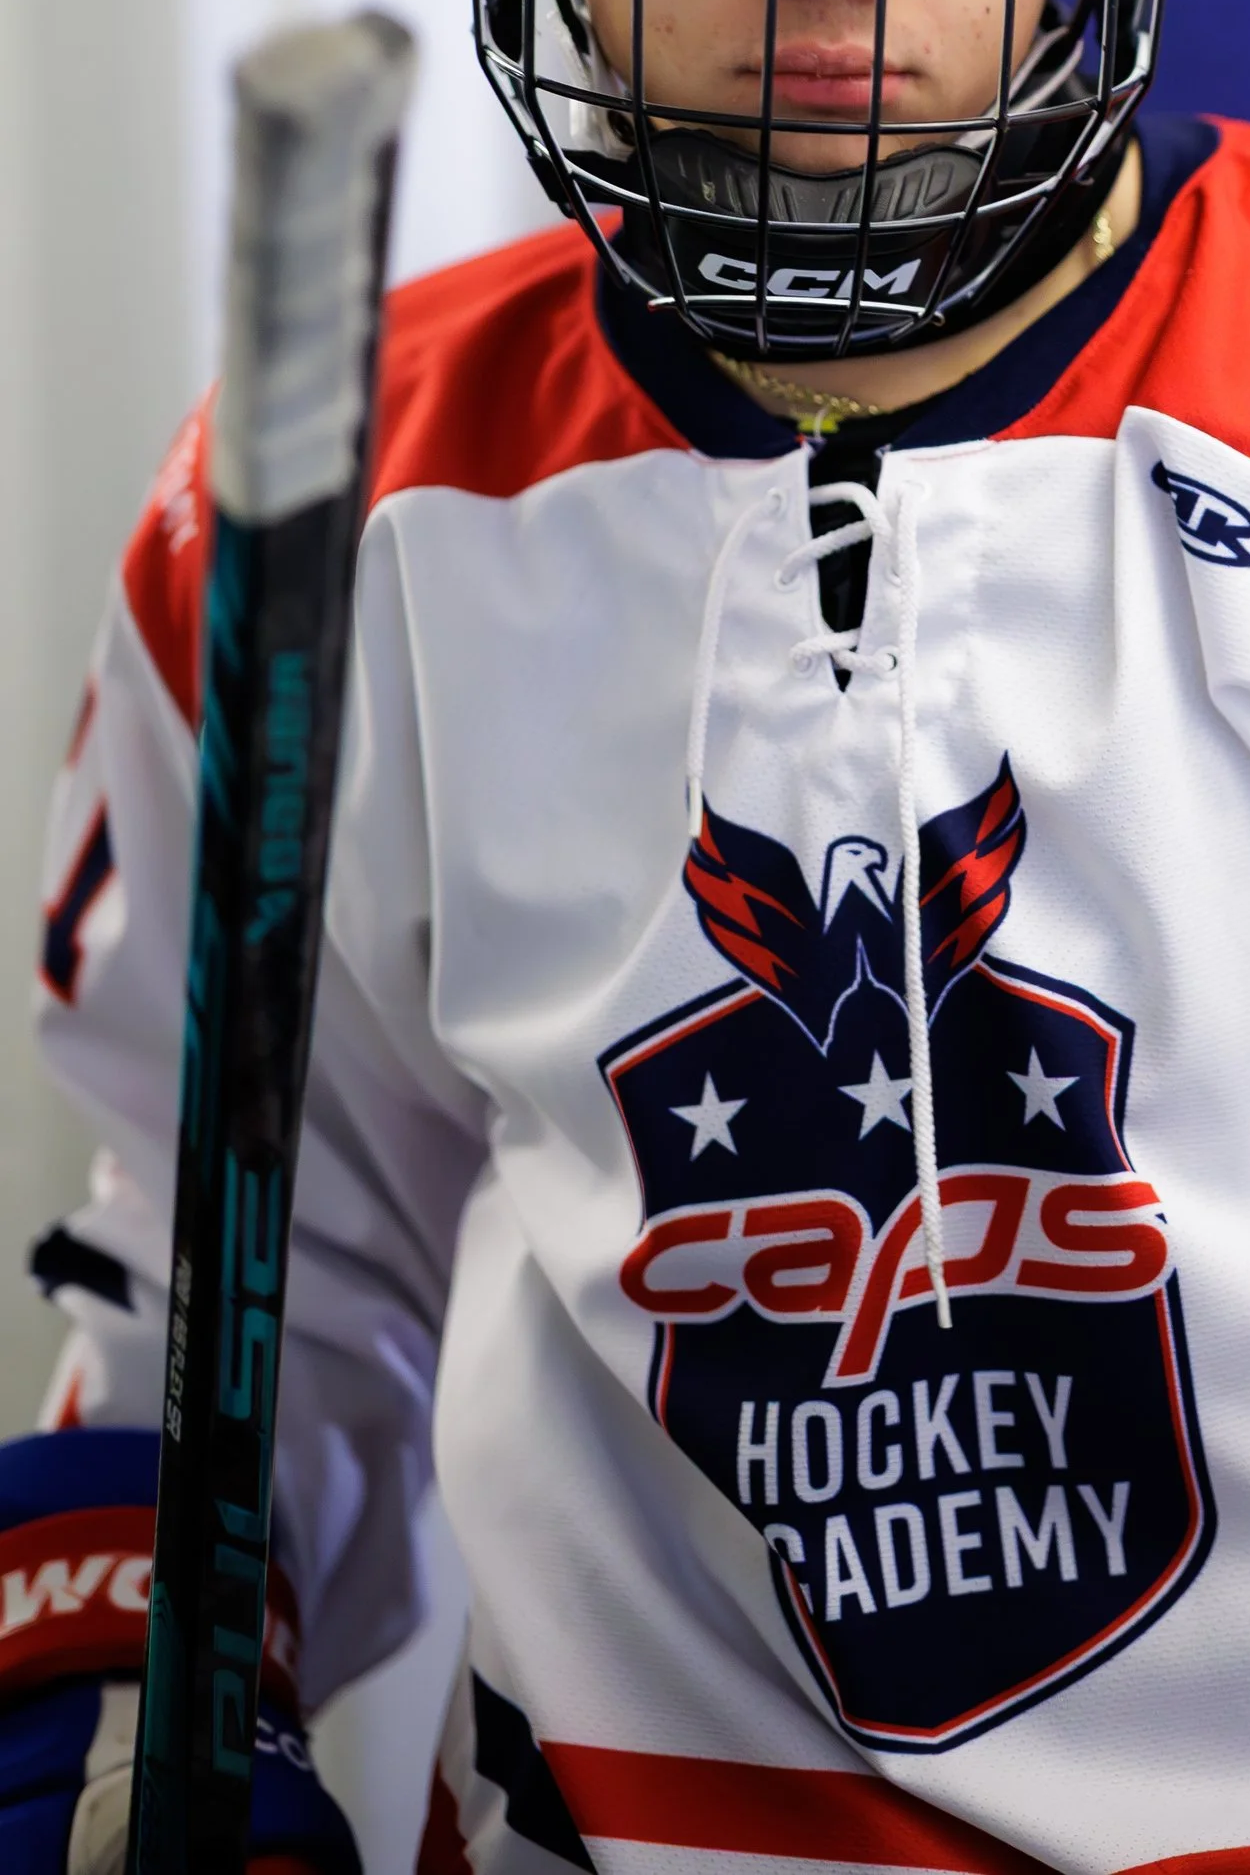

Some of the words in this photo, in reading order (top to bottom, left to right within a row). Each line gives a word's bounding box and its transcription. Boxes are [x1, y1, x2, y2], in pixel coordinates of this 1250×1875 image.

[697, 253, 923, 299] CCM
[618, 1164, 1172, 1388] caps
[735, 1370, 1073, 1506] HOCKEY
[762, 1480, 1131, 1622] CADEMY
